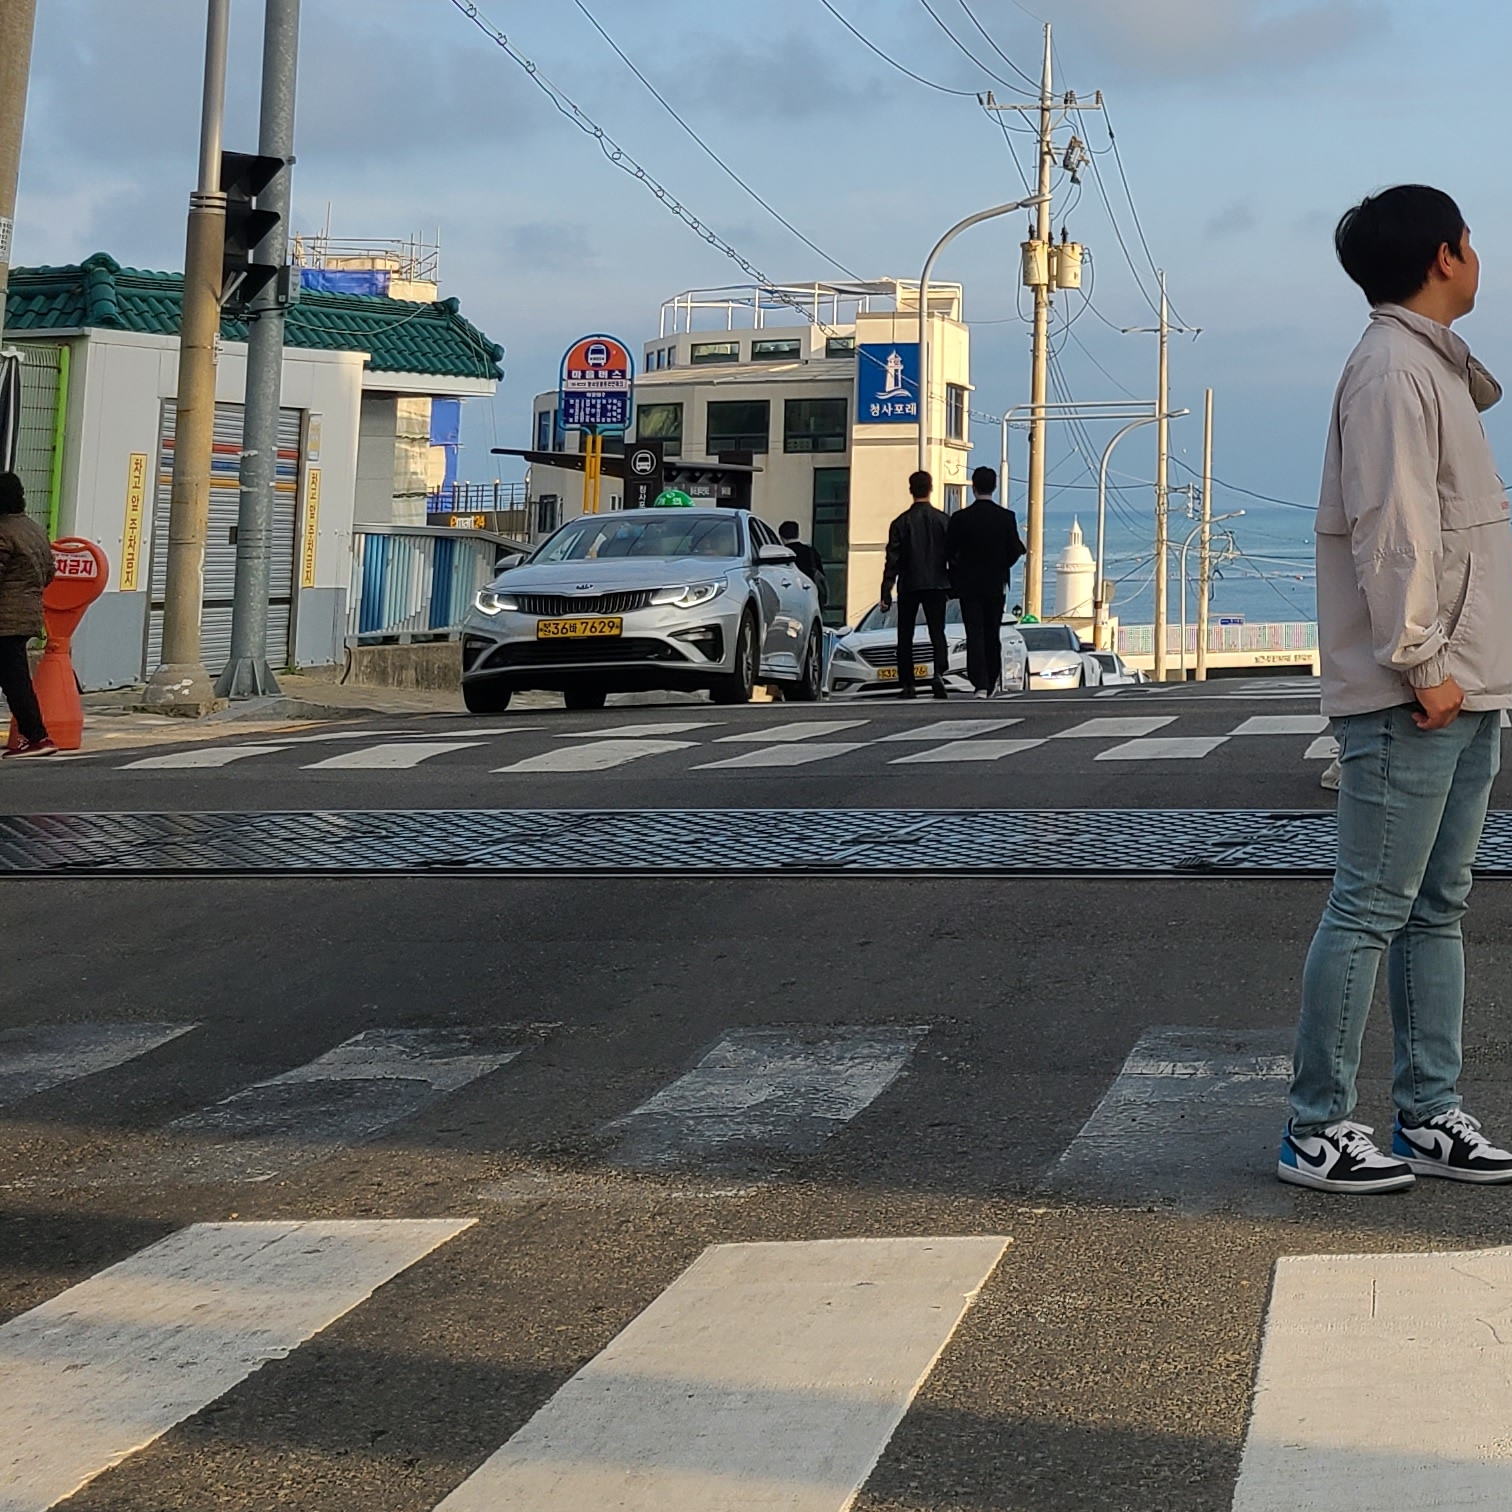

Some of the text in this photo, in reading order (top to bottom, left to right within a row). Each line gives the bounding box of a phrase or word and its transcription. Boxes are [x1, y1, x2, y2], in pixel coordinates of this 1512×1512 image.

[869, 402, 917, 417] 청사포래
[124, 458, 143, 587] 차고 앞 주차금지
[304, 524, 315, 584] 주차금지
[55, 558, 94, 576] 차금지
[580, 620, 615, 635] 7629
